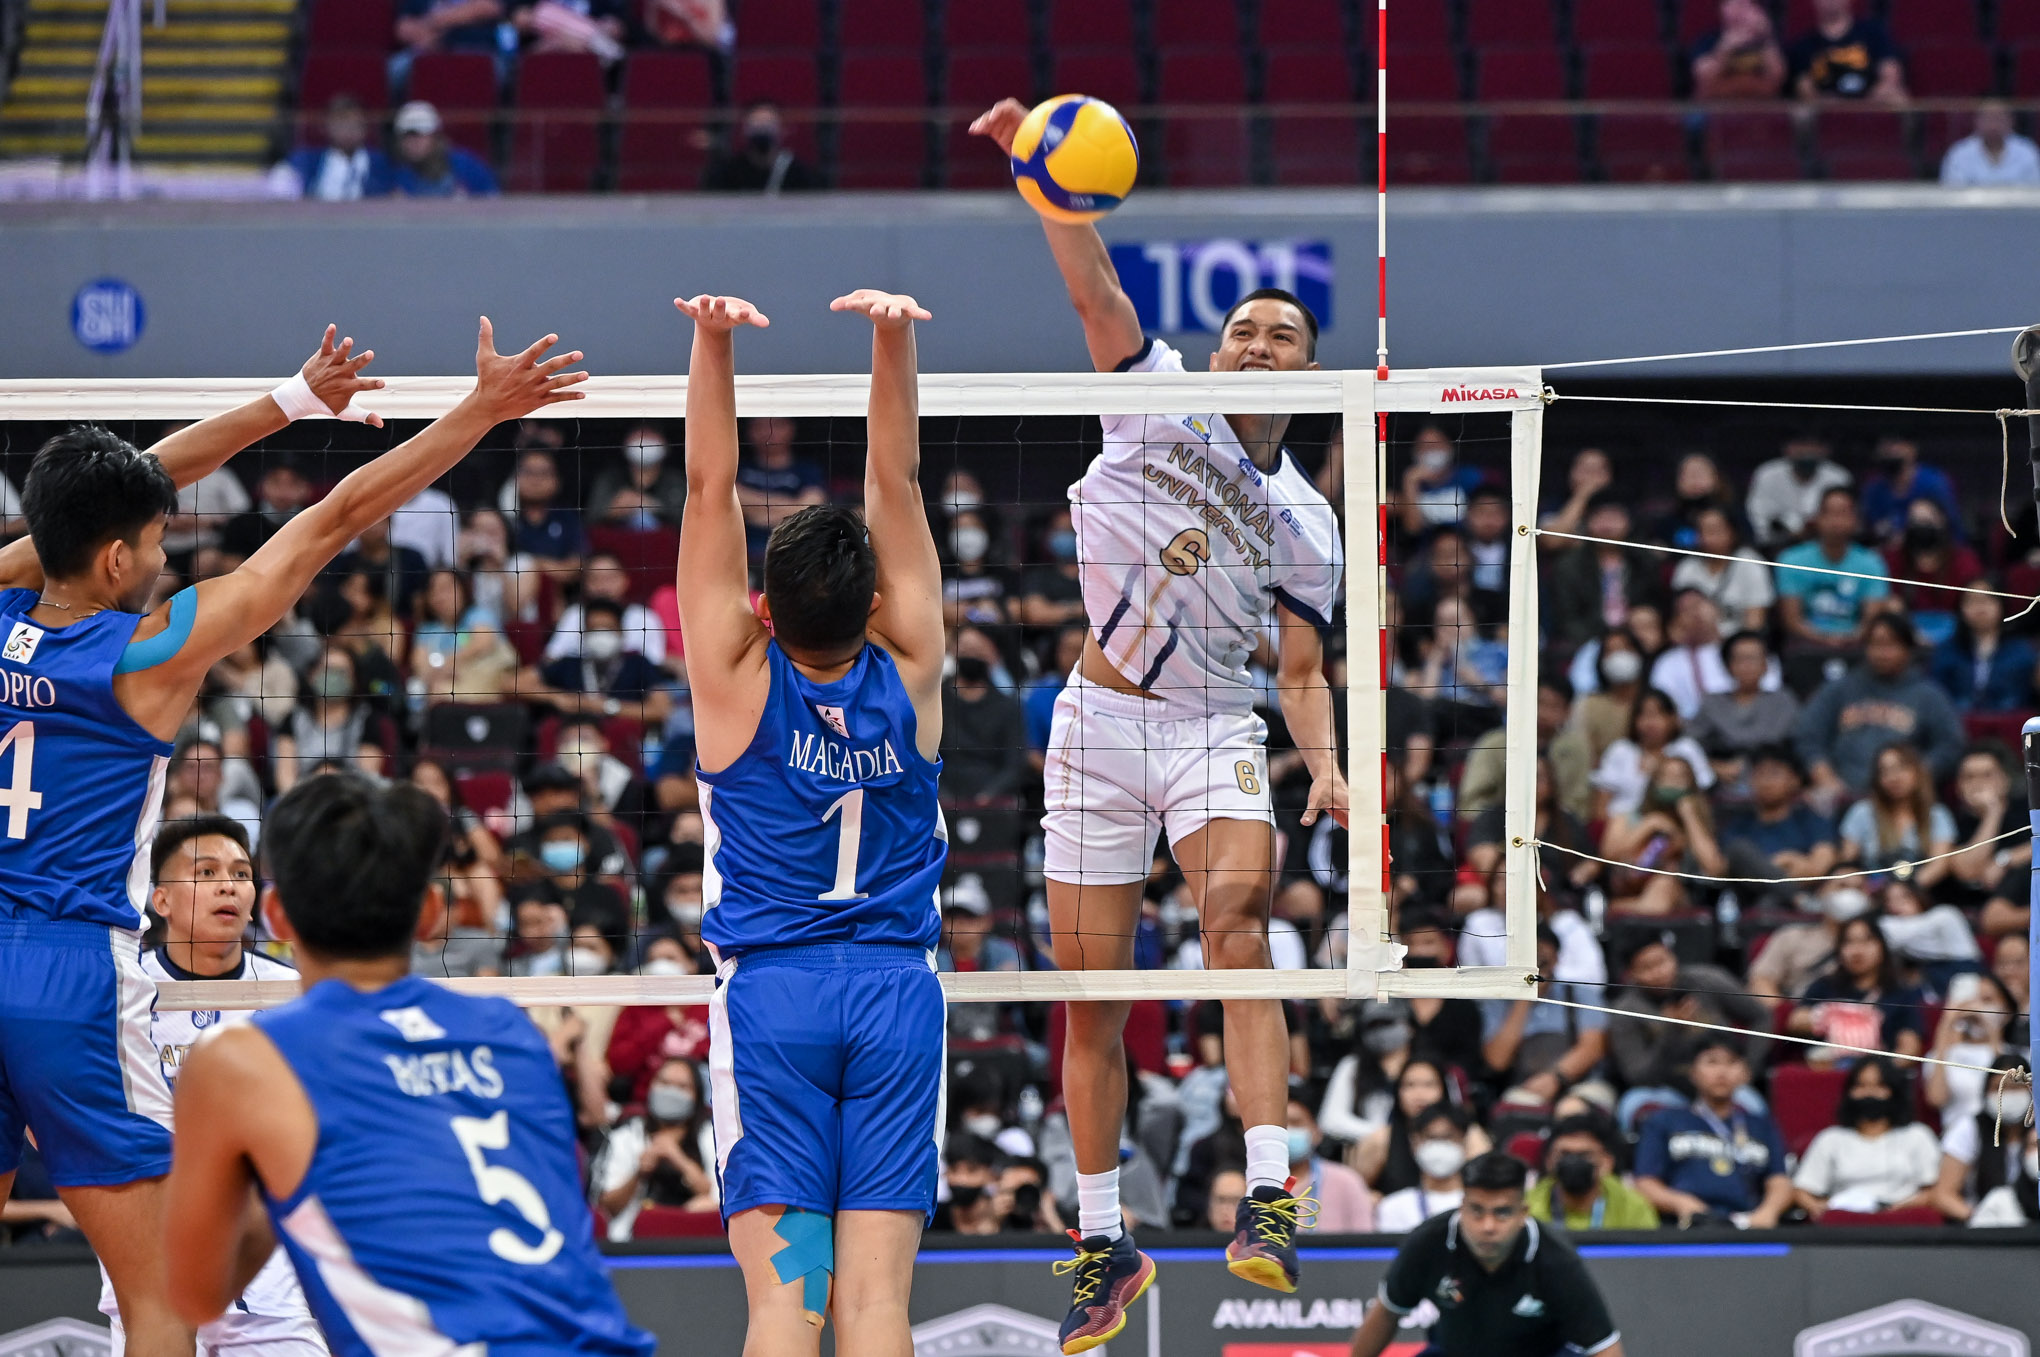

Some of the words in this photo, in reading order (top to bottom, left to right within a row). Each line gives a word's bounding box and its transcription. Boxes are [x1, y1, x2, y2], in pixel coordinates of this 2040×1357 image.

[1142, 238, 1297, 333] 101
[1167, 442, 1275, 547] NATIONAL
[1159, 527, 1211, 576] 6
[788, 729, 904, 783] MAGADIA
[1234, 760, 1261, 795] 6
[817, 788, 869, 901] 1
[450, 1109, 566, 1266] 5
